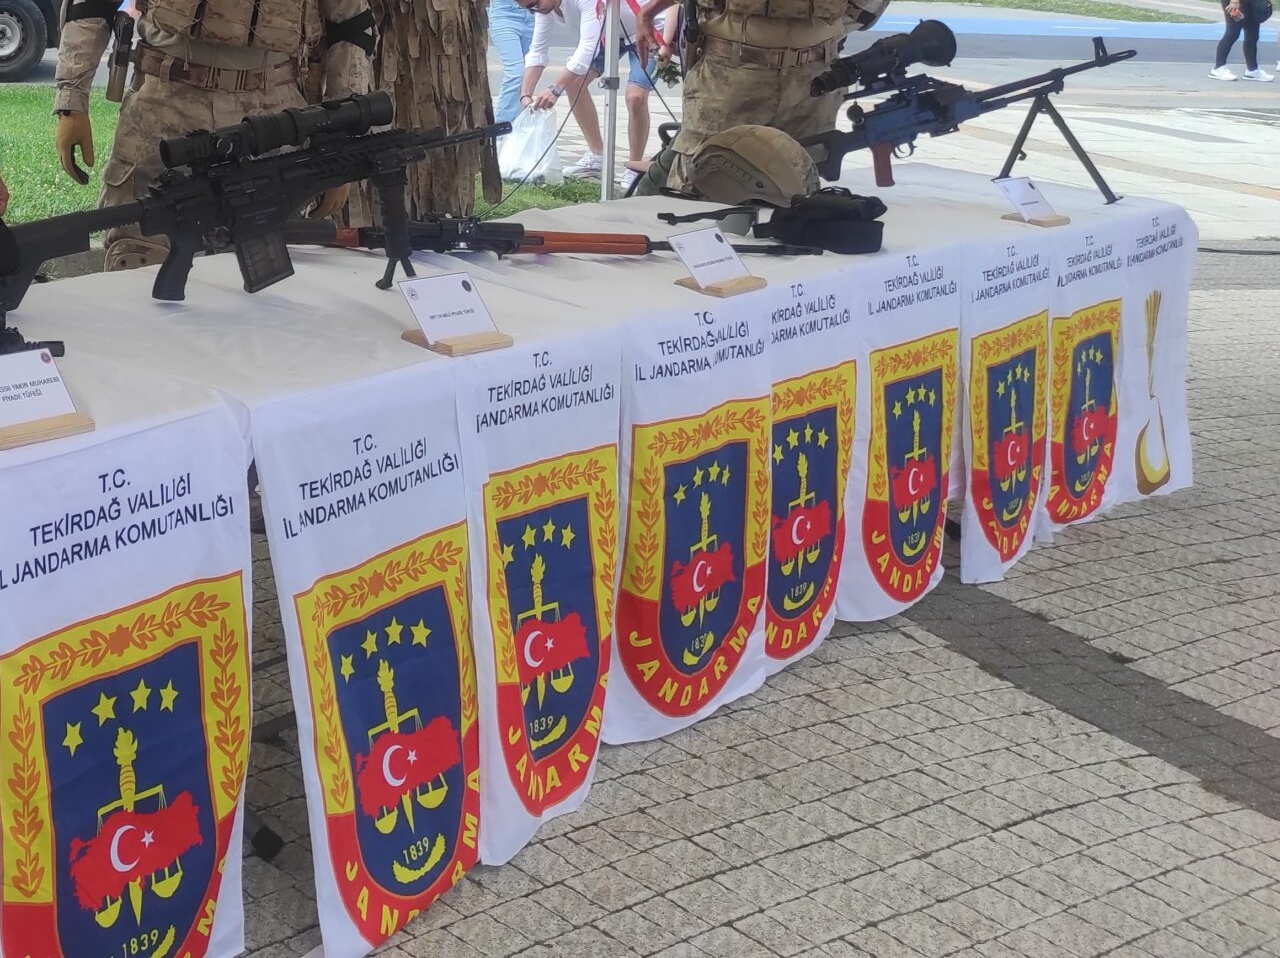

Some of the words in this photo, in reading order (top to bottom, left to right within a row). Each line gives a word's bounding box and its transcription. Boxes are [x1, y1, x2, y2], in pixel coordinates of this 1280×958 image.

[884, 271, 919, 293] TEKİRDAĞ
[772, 303, 803, 325] KİRDAĞ
[875, 293, 915, 314] JANDARMA
[657, 329, 715, 357] TEKİRDAĞ
[532, 351, 552, 368] T.C.
[635, 363, 646, 381] İL
[649, 357, 712, 380] JANDARMA
[713, 338, 765, 367] OMUTANLIĞI
[1, 393, 22, 402] PİYADE
[487, 373, 546, 402] TEKİRDAĞ
[549, 364, 593, 389] VALİLİĞİ
[480, 402, 540, 431] ANDARMA
[541, 383, 614, 414] KOMUTANLIĞI
[353, 433, 377, 455] T.C.
[98, 469, 130, 493] T.C.
[299, 458, 372, 500] TEKİRDAĞ
[376, 437, 427, 474] VALİLİĞİ
[29, 497, 121, 546] TEKİRDAĞ
[127, 473, 191, 515] VALİLİĞİ
[283, 517, 298, 539] İL
[299, 491, 366, 532] ANDARMA
[369, 452, 459, 504] KOMUTANLIĞI
[12, 535, 111, 585] JANDARMA
[115, 494, 234, 549] KOMUTANLIĞI
[629, 595, 761, 707] JANDARMA
[529, 716, 553, 735] 1839
[402, 836, 429, 865] 1839
[122, 929, 159, 958] 1839
